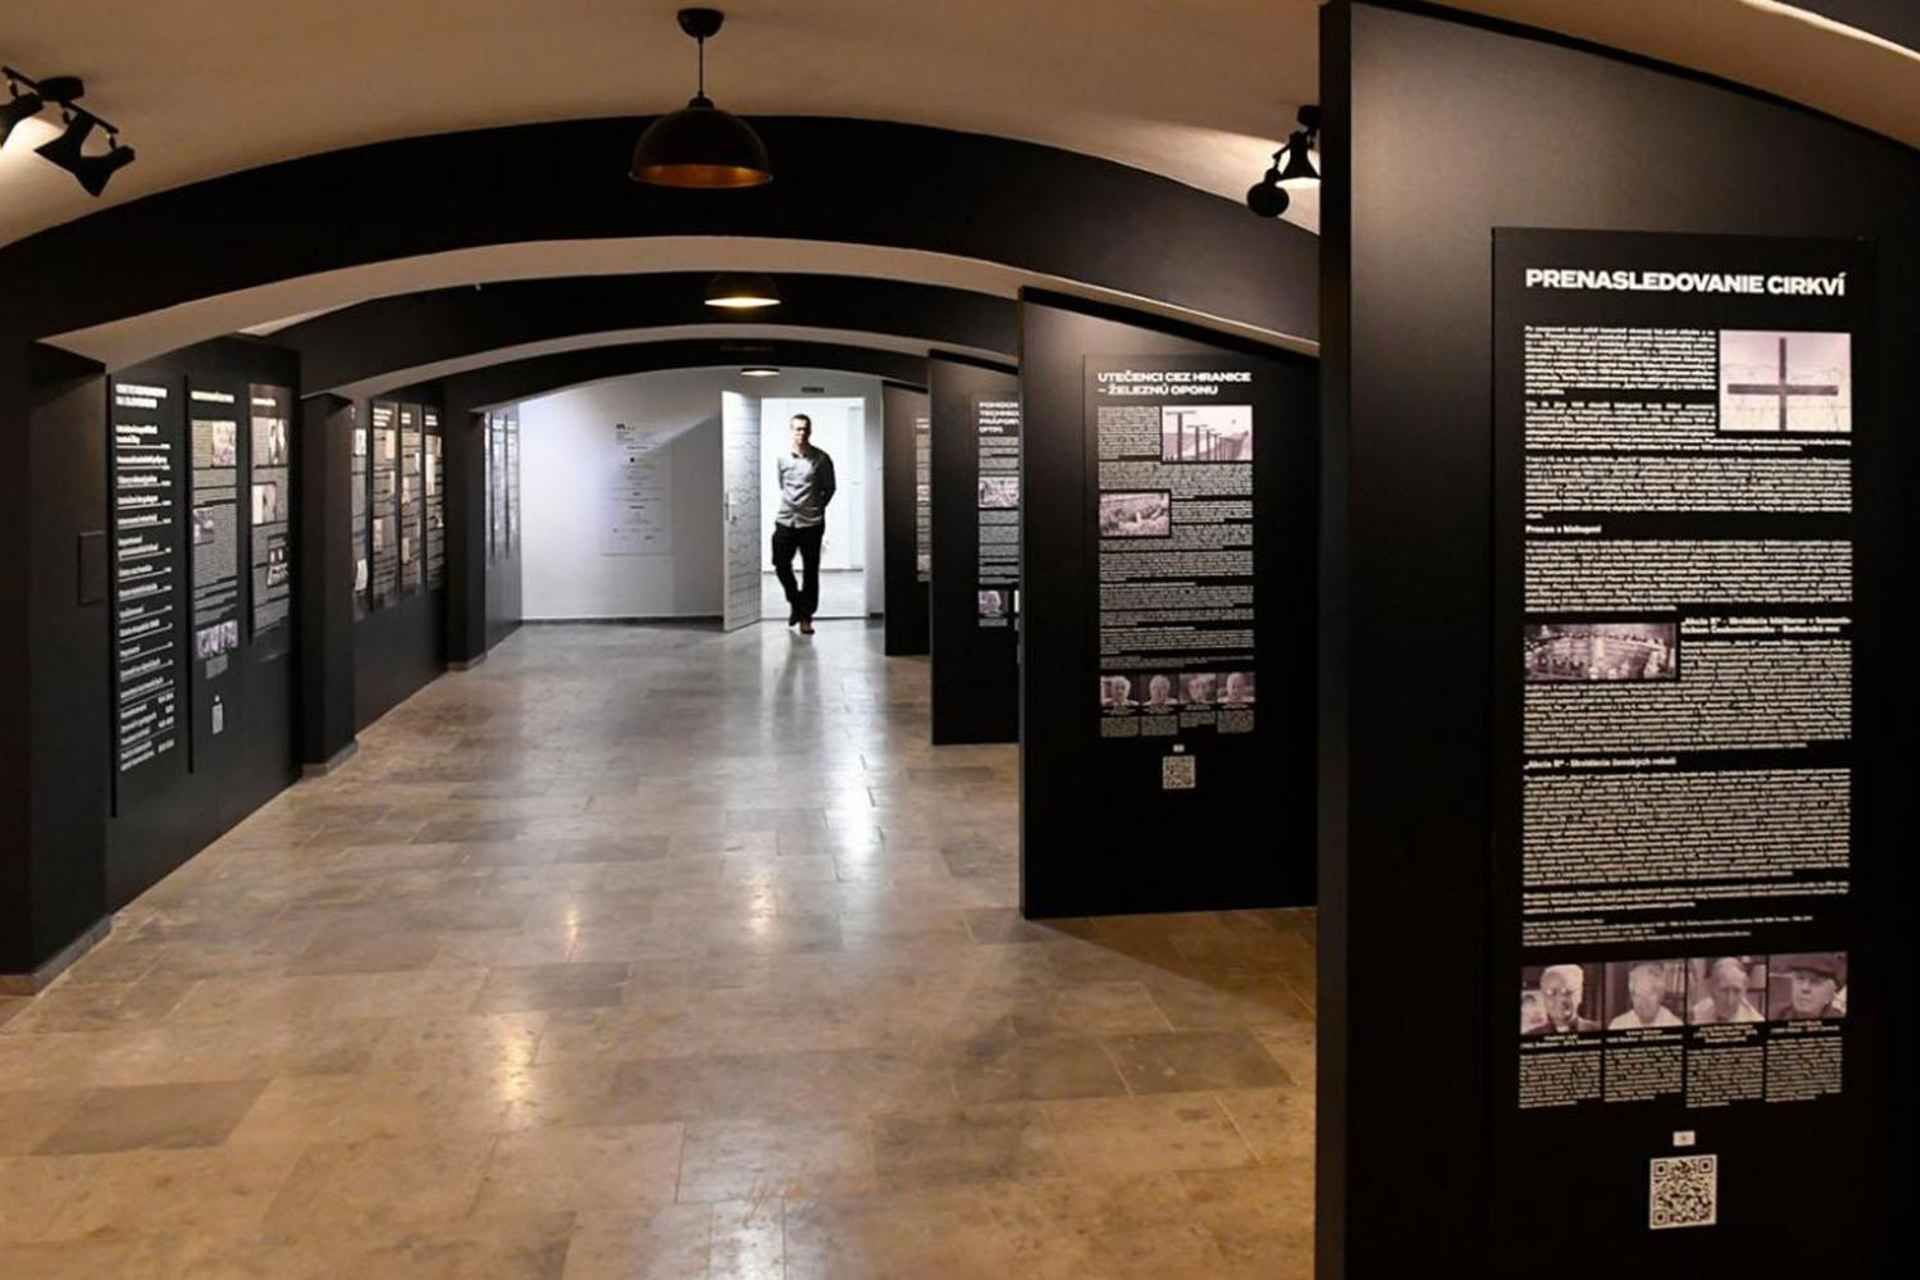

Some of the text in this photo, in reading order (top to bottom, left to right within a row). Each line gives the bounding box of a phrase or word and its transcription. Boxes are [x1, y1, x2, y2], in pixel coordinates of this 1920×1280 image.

[1525, 268, 1846, 296] PRENASLEDOVANIE CIRKVÍ
[1098, 370, 1252, 382] UTEČENCI CEZ HRANICE
[1171, 385, 1219, 396] OPONU
